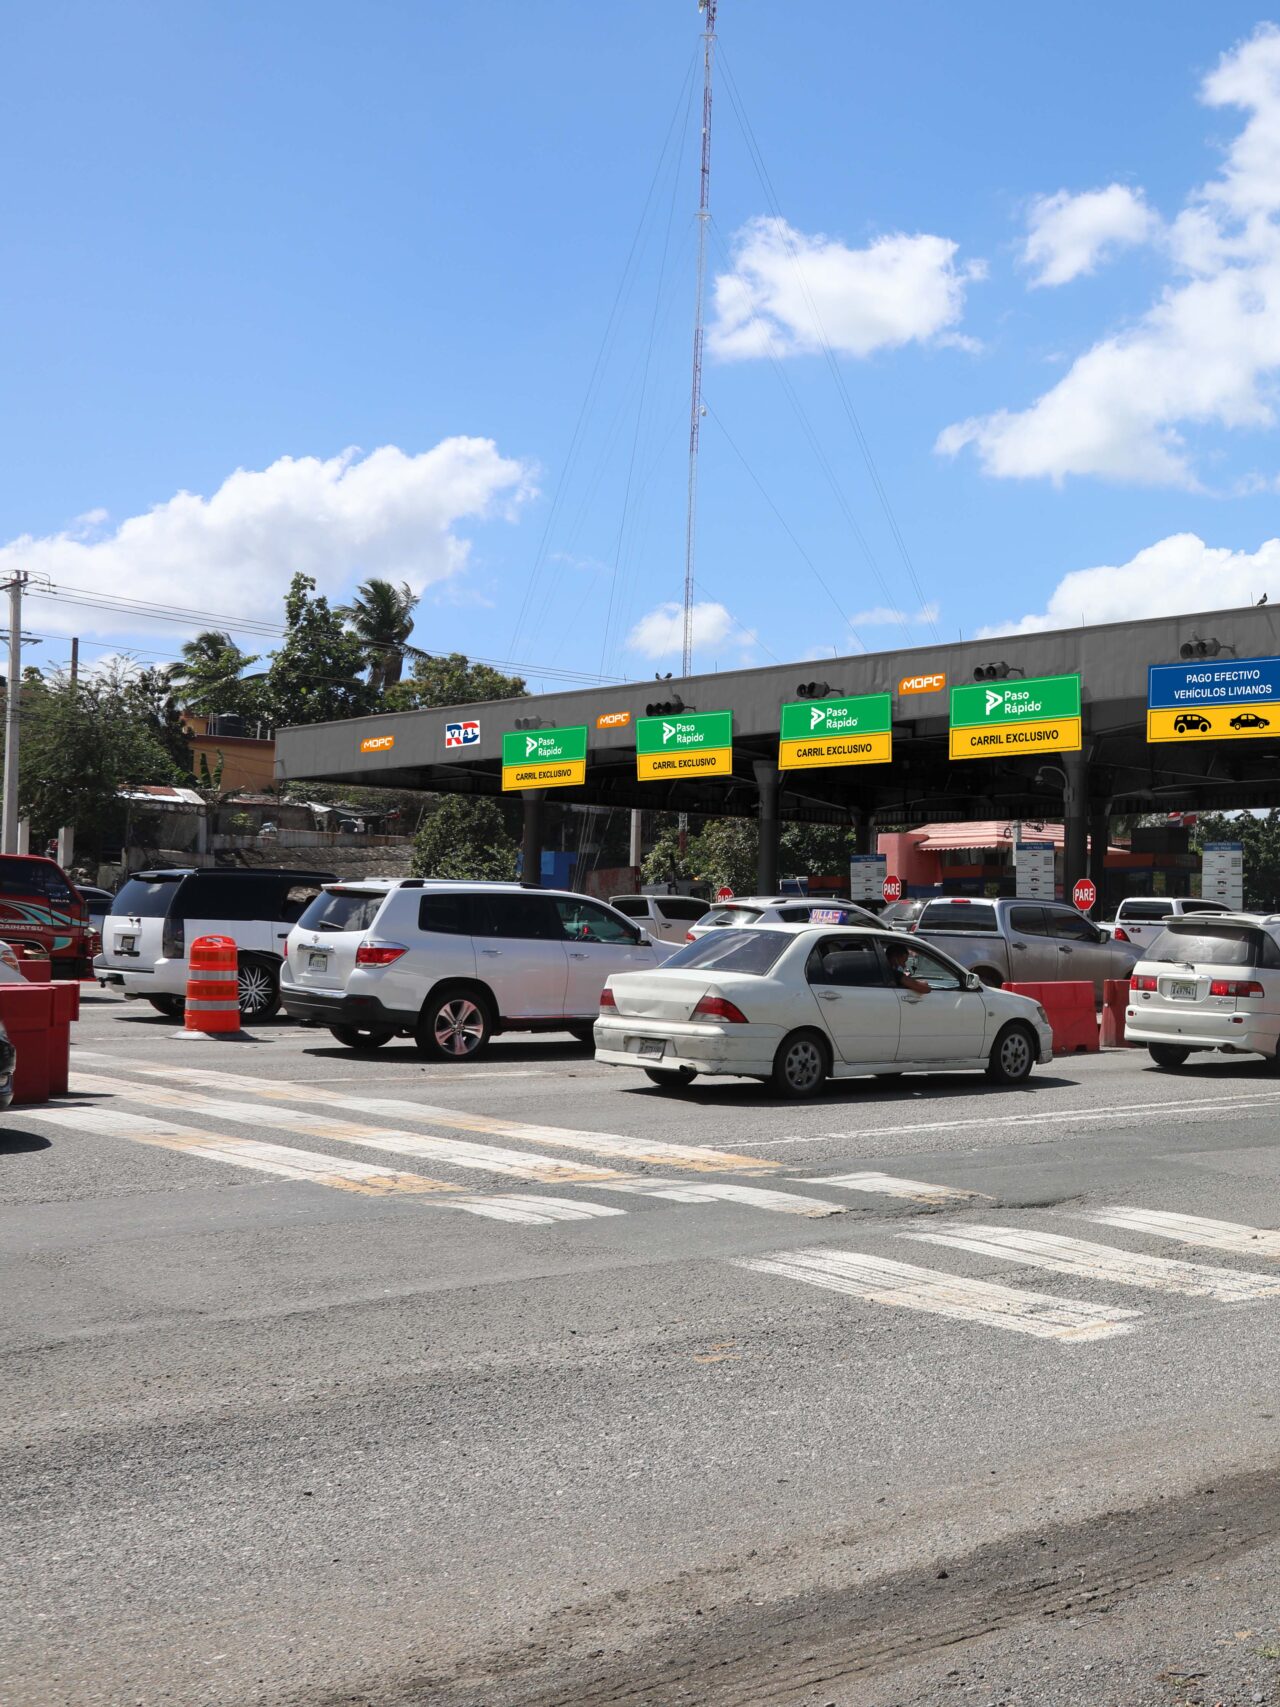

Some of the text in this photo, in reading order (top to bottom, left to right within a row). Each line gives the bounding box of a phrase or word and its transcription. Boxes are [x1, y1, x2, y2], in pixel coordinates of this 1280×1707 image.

[903, 675, 944, 690] MOPC
[1186, 669, 1261, 684] PAGO EFECTIVO
[1004, 690, 1030, 702] Paso
[1174, 684, 1273, 700] VEHÍCULOS LIVIANOS
[826, 707, 848, 718] Paso
[1004, 701, 1041, 716] Rápido
[600, 713, 628, 726] MOPC
[826, 717, 857, 730] Rápido
[450, 728, 477, 738] VIAL
[676, 723, 696, 734] Paso
[364, 737, 393, 748] MOPC
[538, 737, 556, 747] Paso
[676, 731, 704, 745] Rápido
[970, 729, 1059, 747] CARRIL EXCLUSIVO
[538, 745, 563, 758] Rápido
[796, 743, 872, 758] CARRIL EXCLUSIVO
[652, 757, 717, 771] CARRIL EXCLUSIVO
[516, 768, 572, 781] CARRIL EXCLUSIVO
[884, 883, 900, 896] PARE
[1074, 888, 1094, 901] PARE
[812, 910, 833, 920] VILLA
